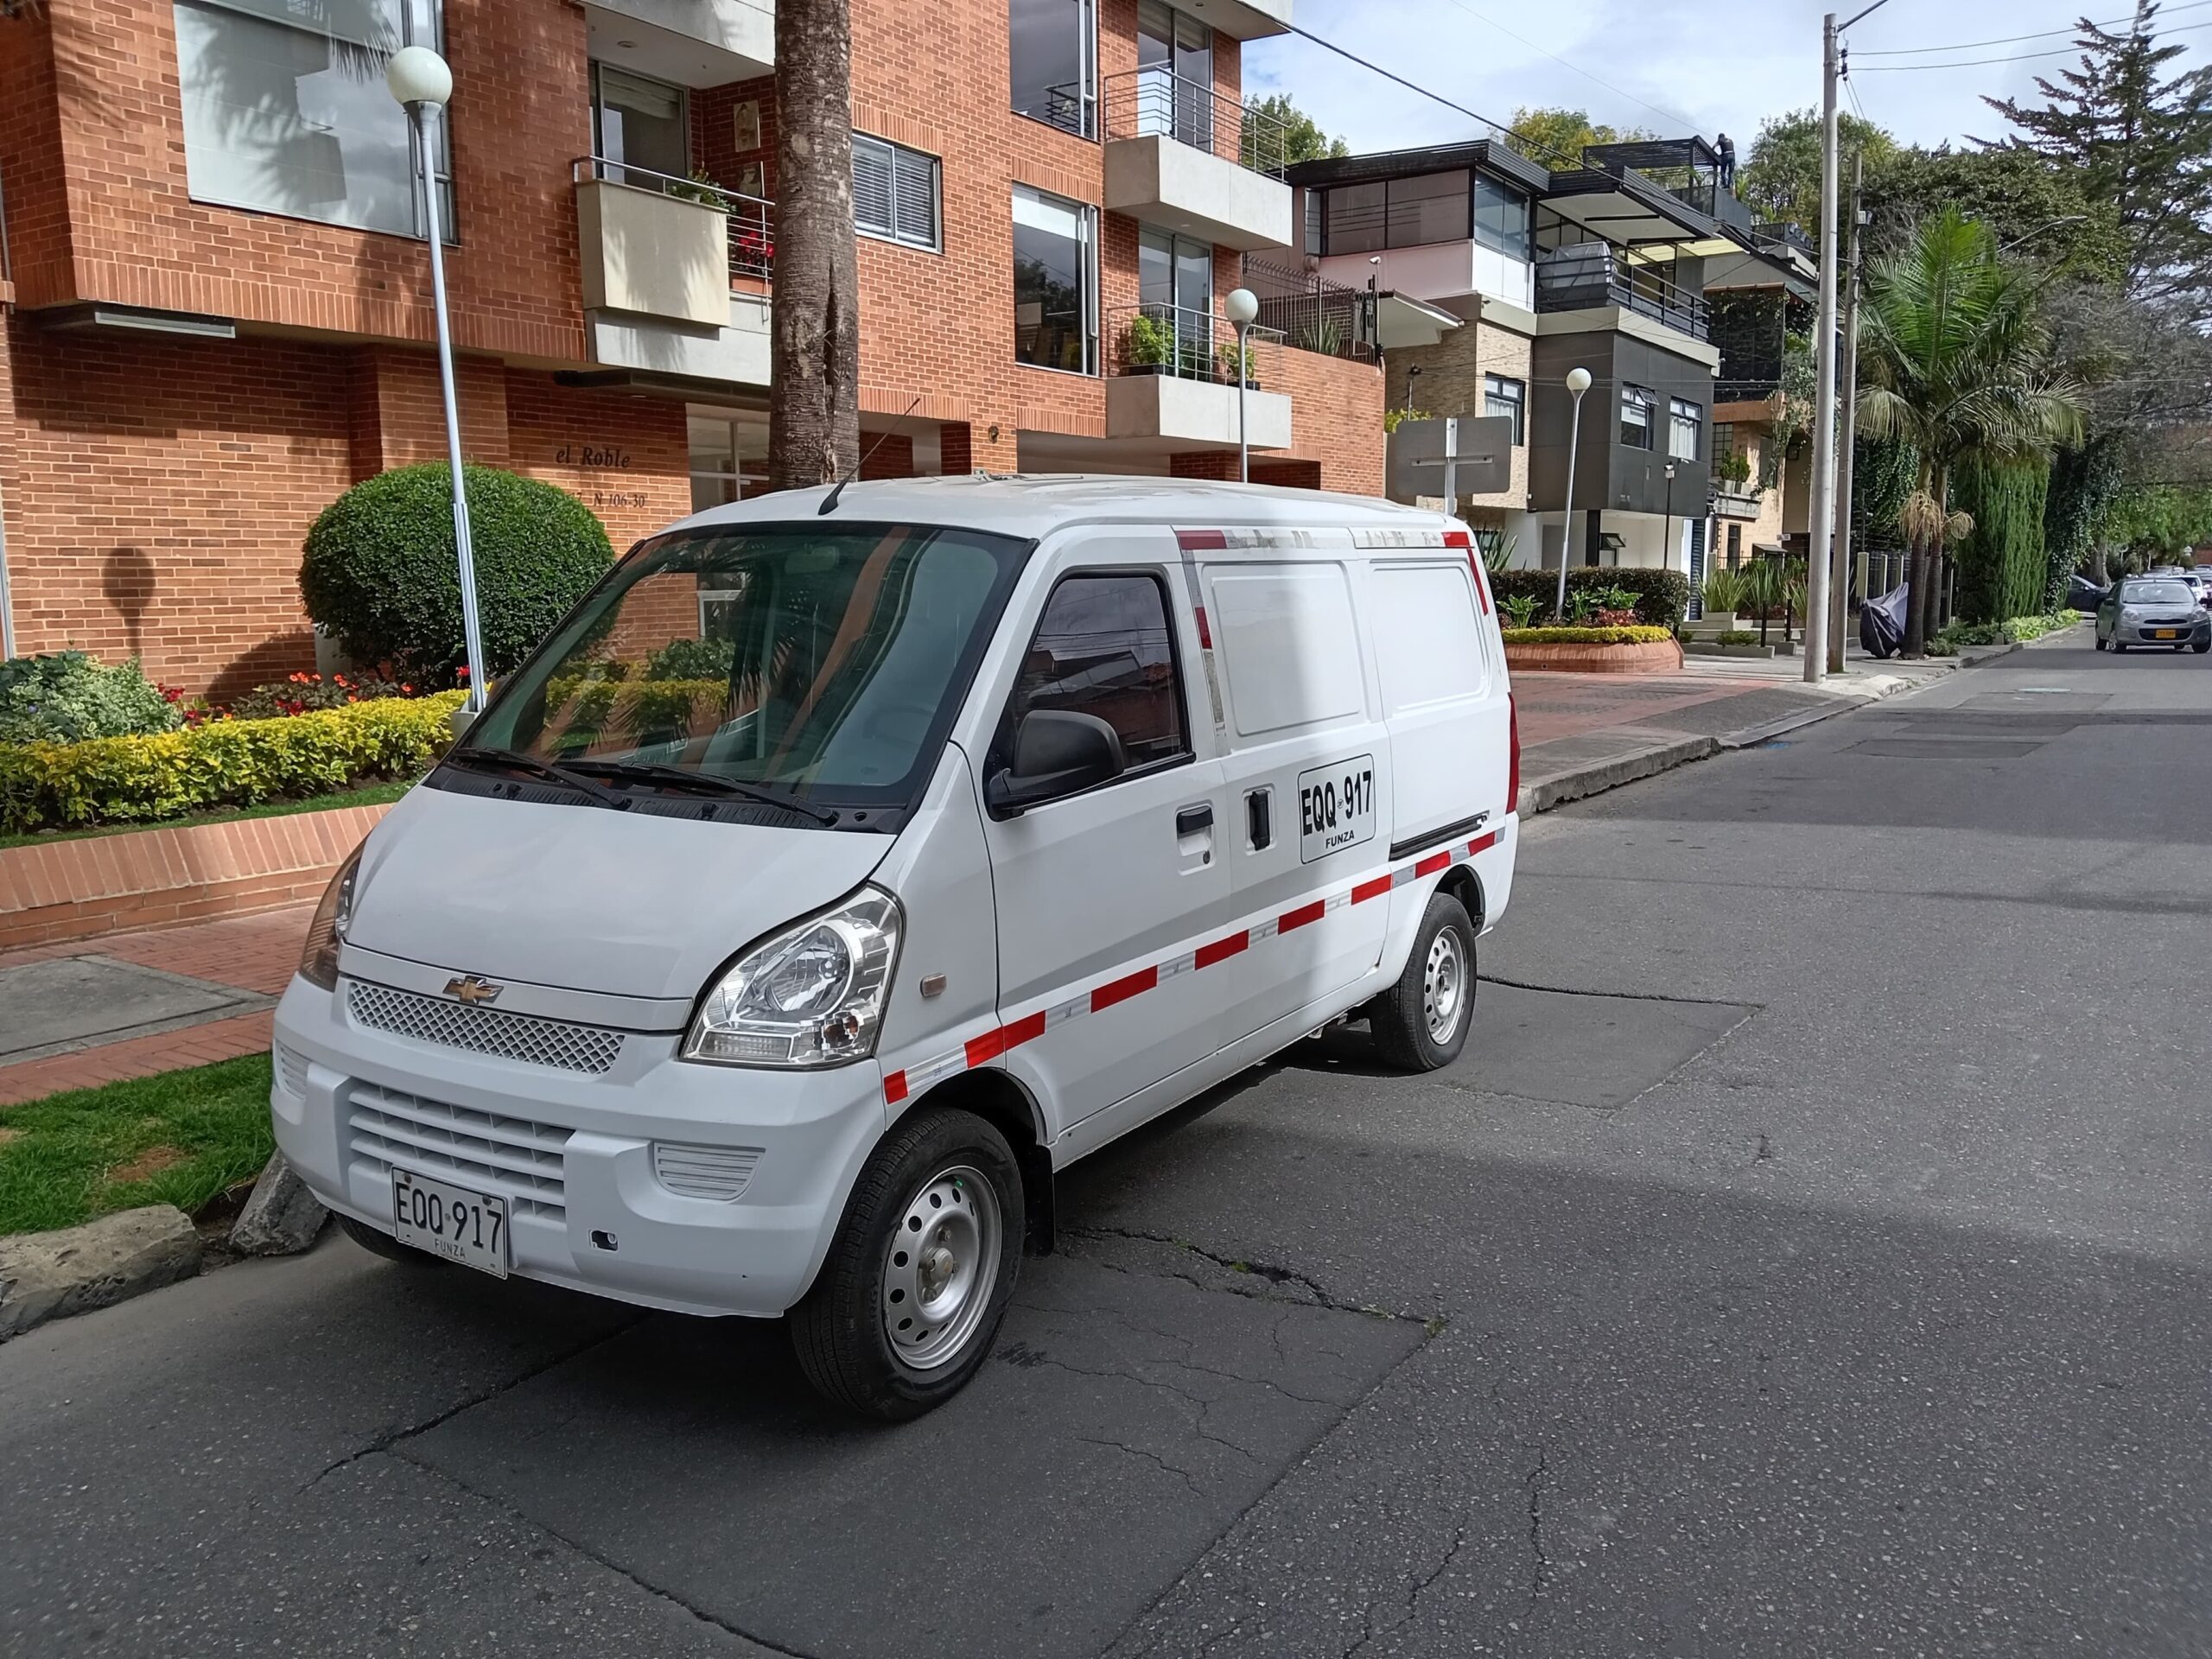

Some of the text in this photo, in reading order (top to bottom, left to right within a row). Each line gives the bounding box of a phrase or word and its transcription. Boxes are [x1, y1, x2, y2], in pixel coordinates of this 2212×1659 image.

[556, 445, 631, 468] el Roble
[593, 493, 604, 507] N
[608, 493, 645, 508] 106-30
[1300, 770, 1371, 836] EQQ 917
[1325, 830, 1355, 849] FUNZA
[396, 1181, 503, 1254] EQQ 917
[434, 1237, 466, 1259] FUNZA
